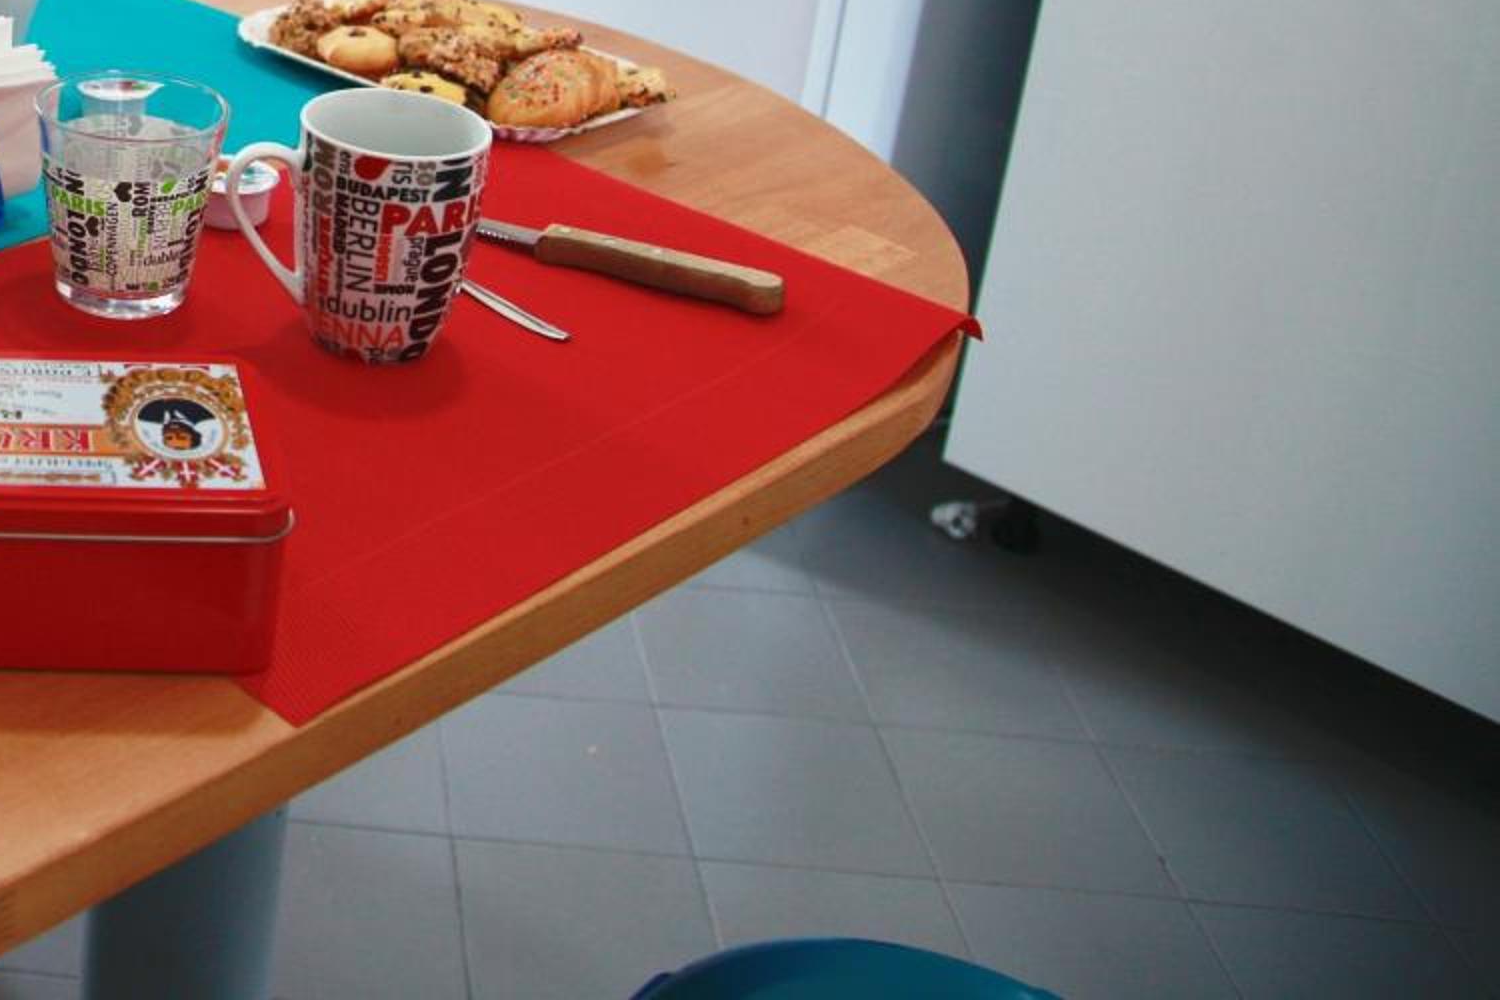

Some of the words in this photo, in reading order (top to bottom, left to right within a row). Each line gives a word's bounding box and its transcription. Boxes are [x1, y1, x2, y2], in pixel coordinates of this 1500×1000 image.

[52, 185, 105, 216] PARIS
[336, 175, 430, 203] BUDAPEST
[105, 201, 119, 276] COPENHAGEN
[345, 199, 381, 294] BERLIN
[402, 235, 425, 283] prague
[327, 296, 411, 323] dublin
